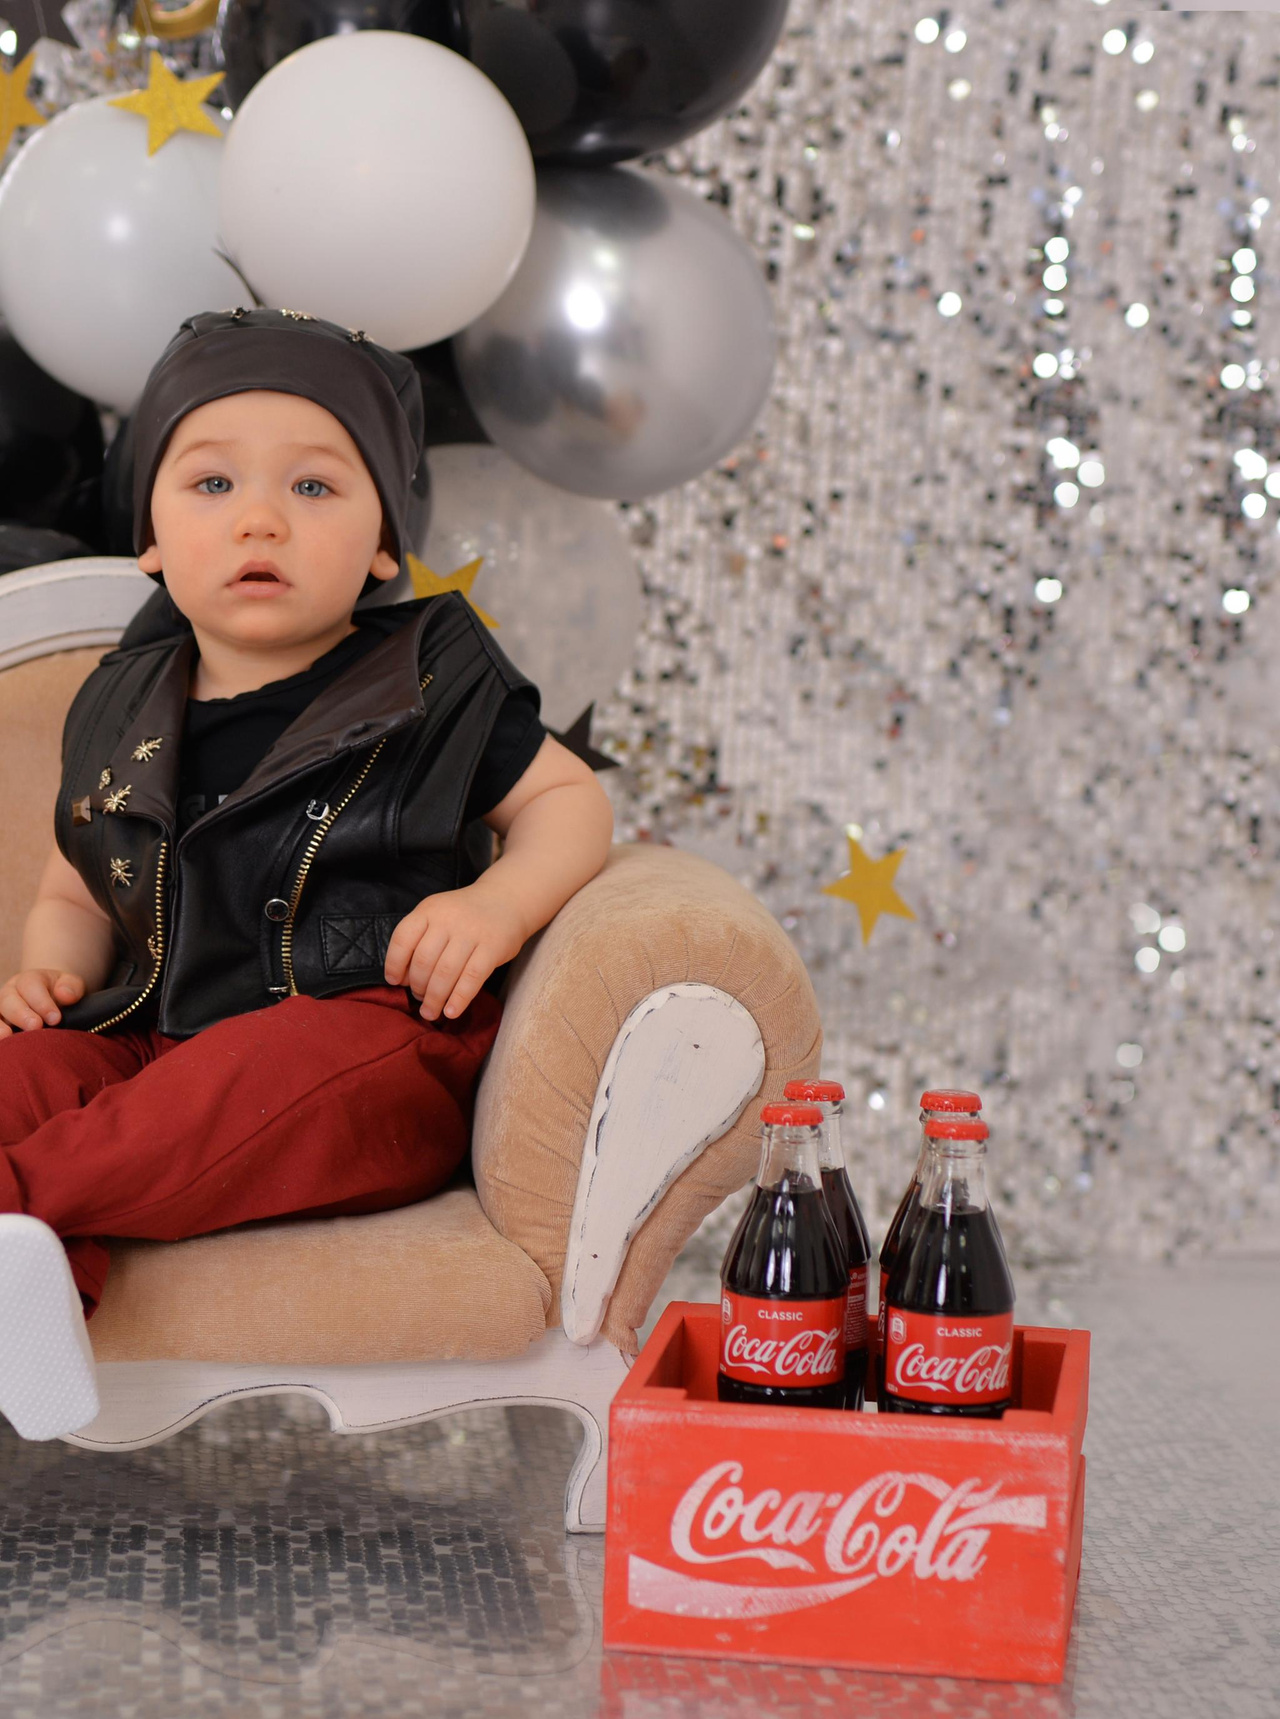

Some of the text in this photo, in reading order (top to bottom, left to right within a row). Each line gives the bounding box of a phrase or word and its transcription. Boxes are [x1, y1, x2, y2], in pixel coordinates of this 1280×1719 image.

[757, 1309, 804, 1322] CLASSIC
[936, 1326, 983, 1338] CLASSIC
[724, 1324, 841, 1377] Coca-Cola
[894, 1341, 1013, 1394] Coca-Cola
[670, 1460, 1004, 1582] Coca-Cola
